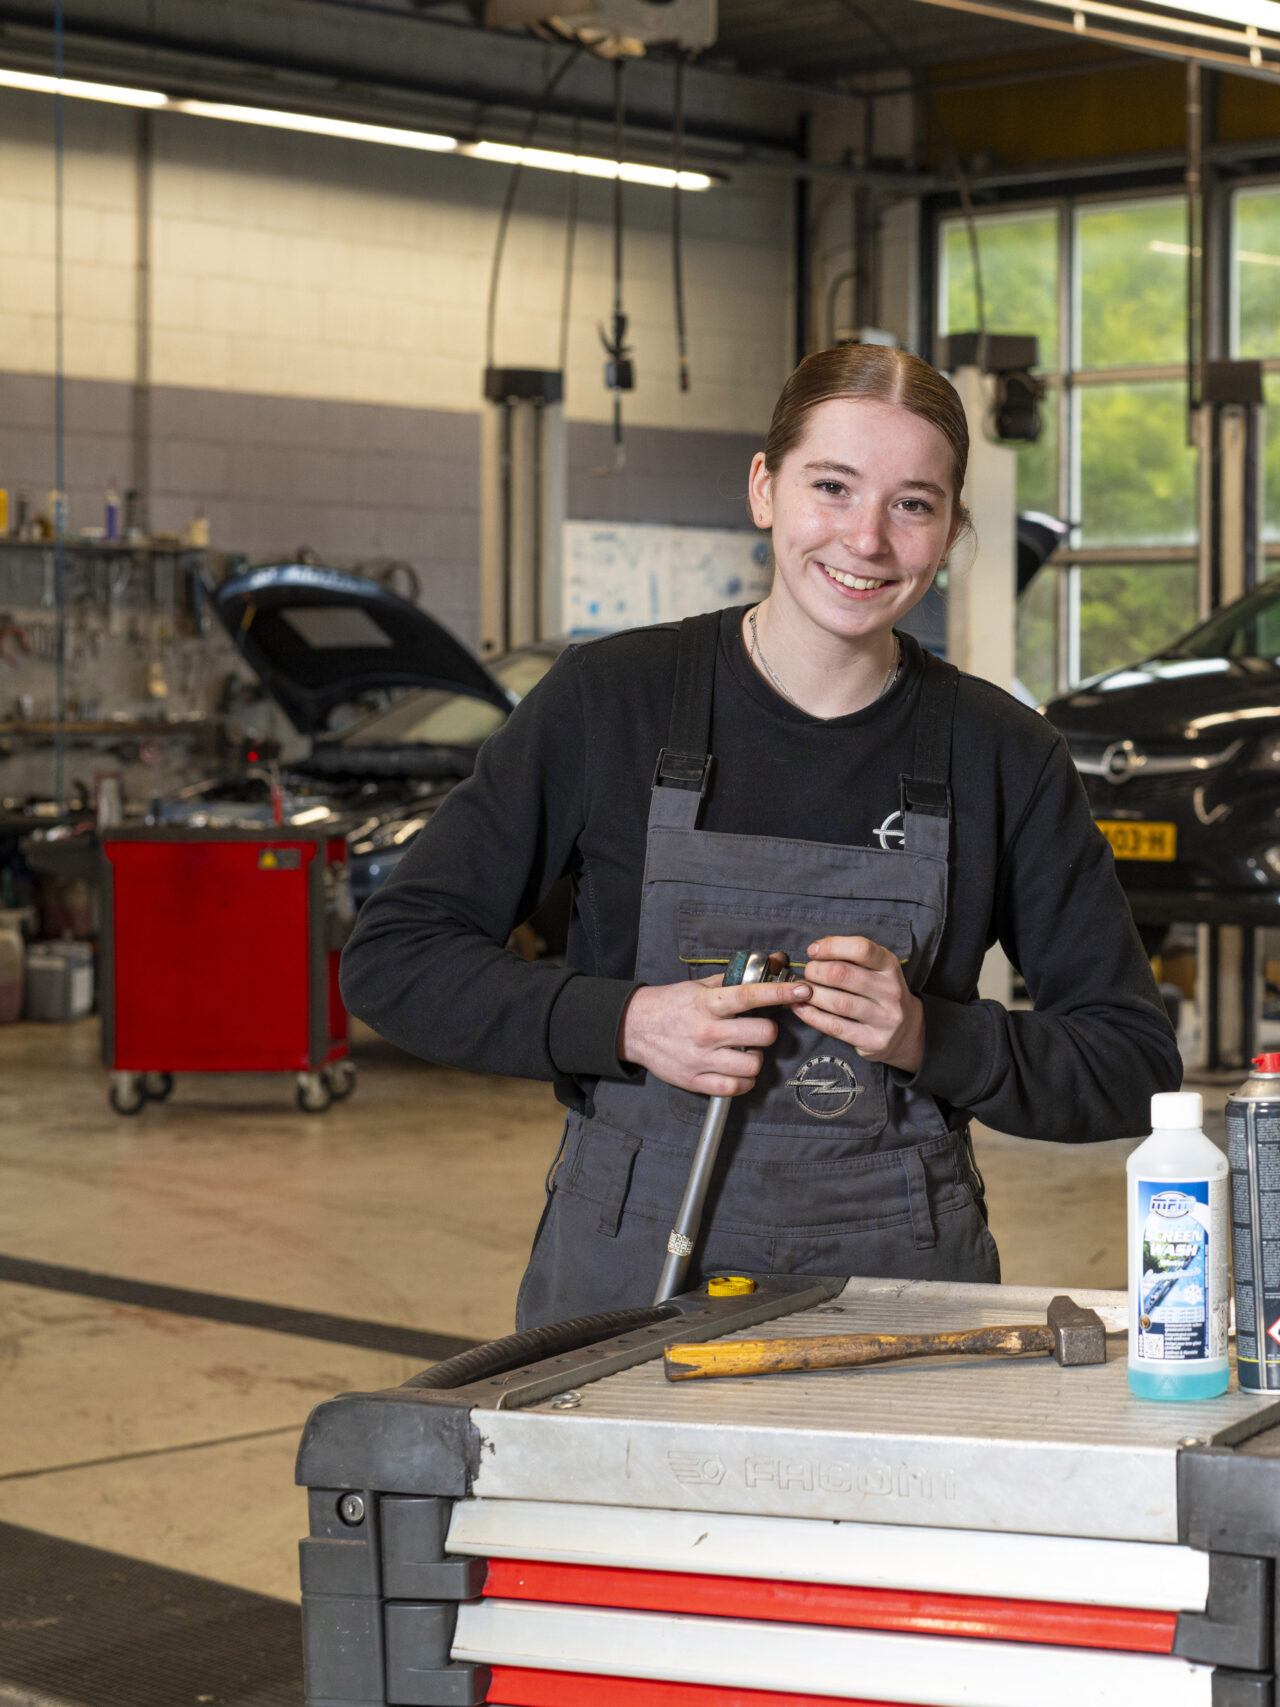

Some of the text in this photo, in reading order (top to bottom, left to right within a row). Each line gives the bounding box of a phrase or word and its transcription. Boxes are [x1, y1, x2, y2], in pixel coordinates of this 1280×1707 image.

[806, 1056, 846, 1069] OPEL
[1144, 1230, 1202, 1243] SCREEN
[1150, 1243, 1199, 1257] WASH
